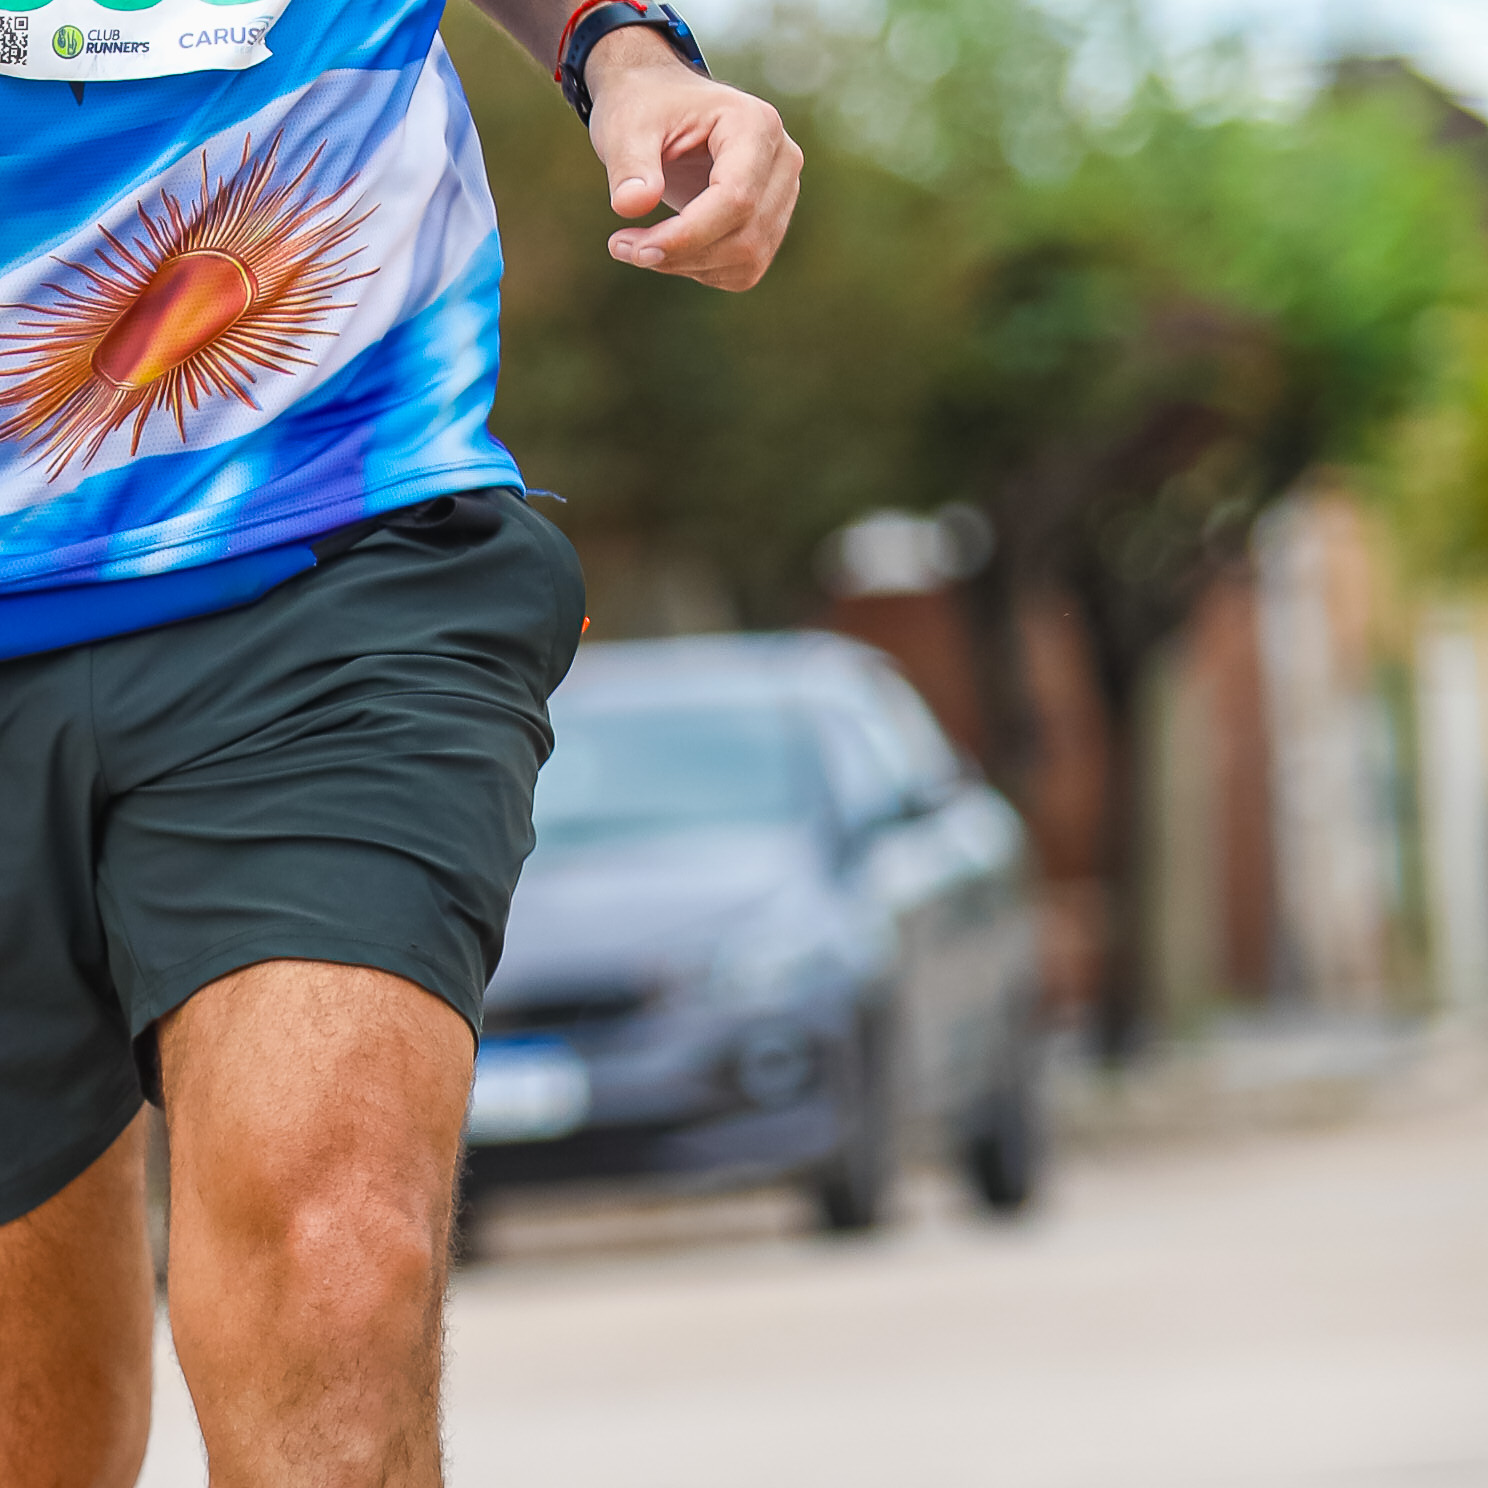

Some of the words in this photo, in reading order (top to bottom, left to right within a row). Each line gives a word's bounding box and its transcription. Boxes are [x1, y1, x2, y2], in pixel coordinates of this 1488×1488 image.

[87, 29, 120, 41] CLUB
[178, 26, 266, 49] CARUS
[85, 41, 150, 54] RUNNER'S
